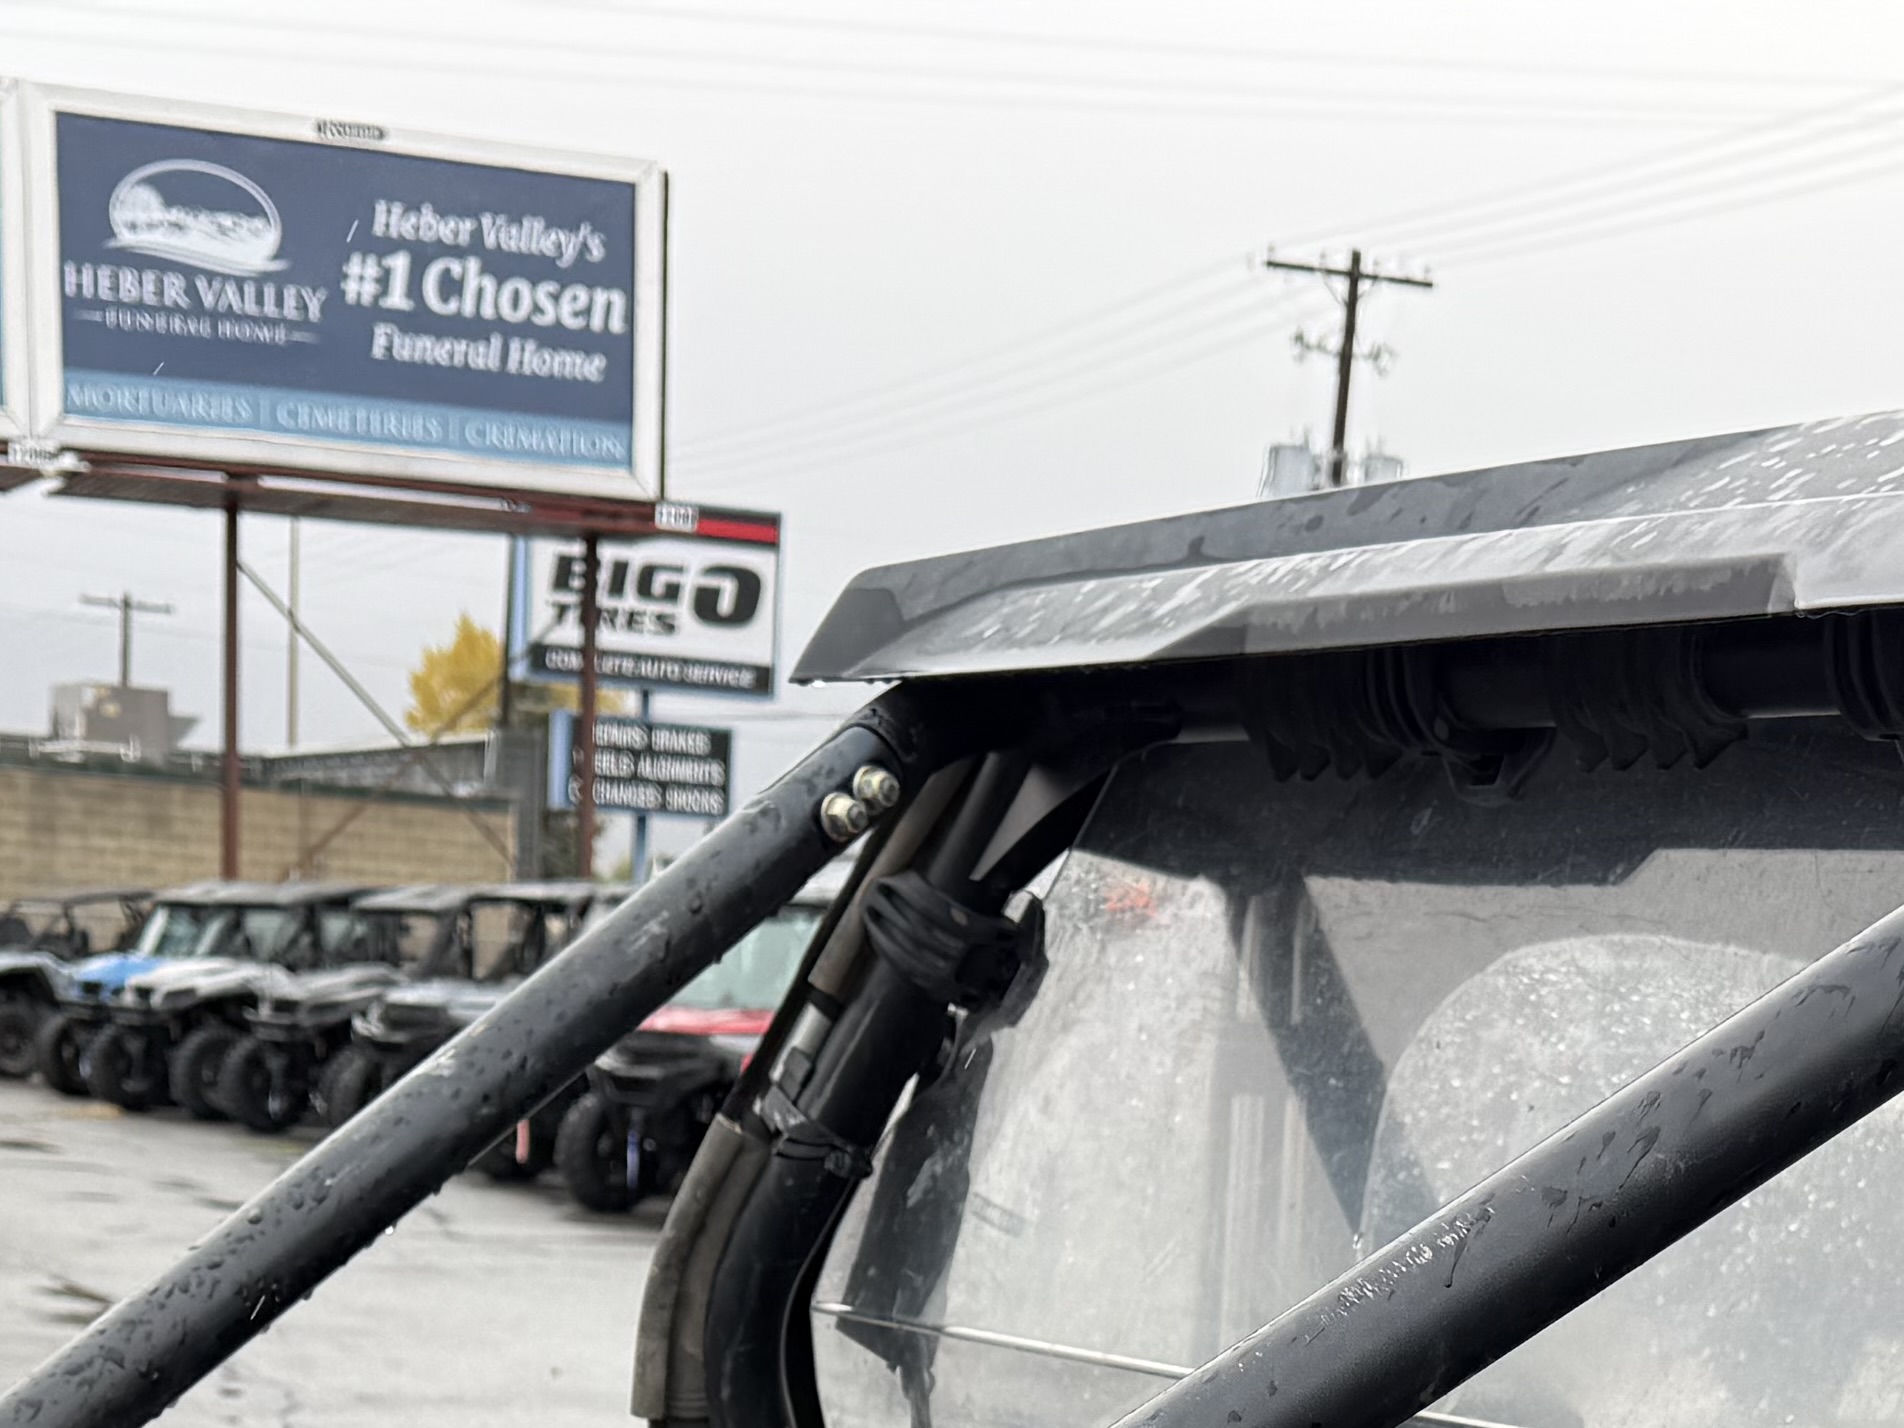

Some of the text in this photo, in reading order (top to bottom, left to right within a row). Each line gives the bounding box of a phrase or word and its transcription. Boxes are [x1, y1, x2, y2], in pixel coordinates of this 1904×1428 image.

[372, 198, 607, 269] Heber Valley's
[63, 260, 328, 323] HEBER VALLEY
[340, 249, 629, 334] #1 Chosen
[105, 305, 287, 345] FUNERAL HOME
[370, 321, 608, 383] Funeral Home
[67, 383, 627, 459] MORTUARIES CEMETERIES CREMATION
[552, 554, 684, 603] BIG
[549, 602, 677, 634] TRES
[546, 649, 640, 677] COMLETE
[592, 722, 711, 756] EPAIRS BRAKES
[637, 752, 725, 787] ALIGNMENTS
